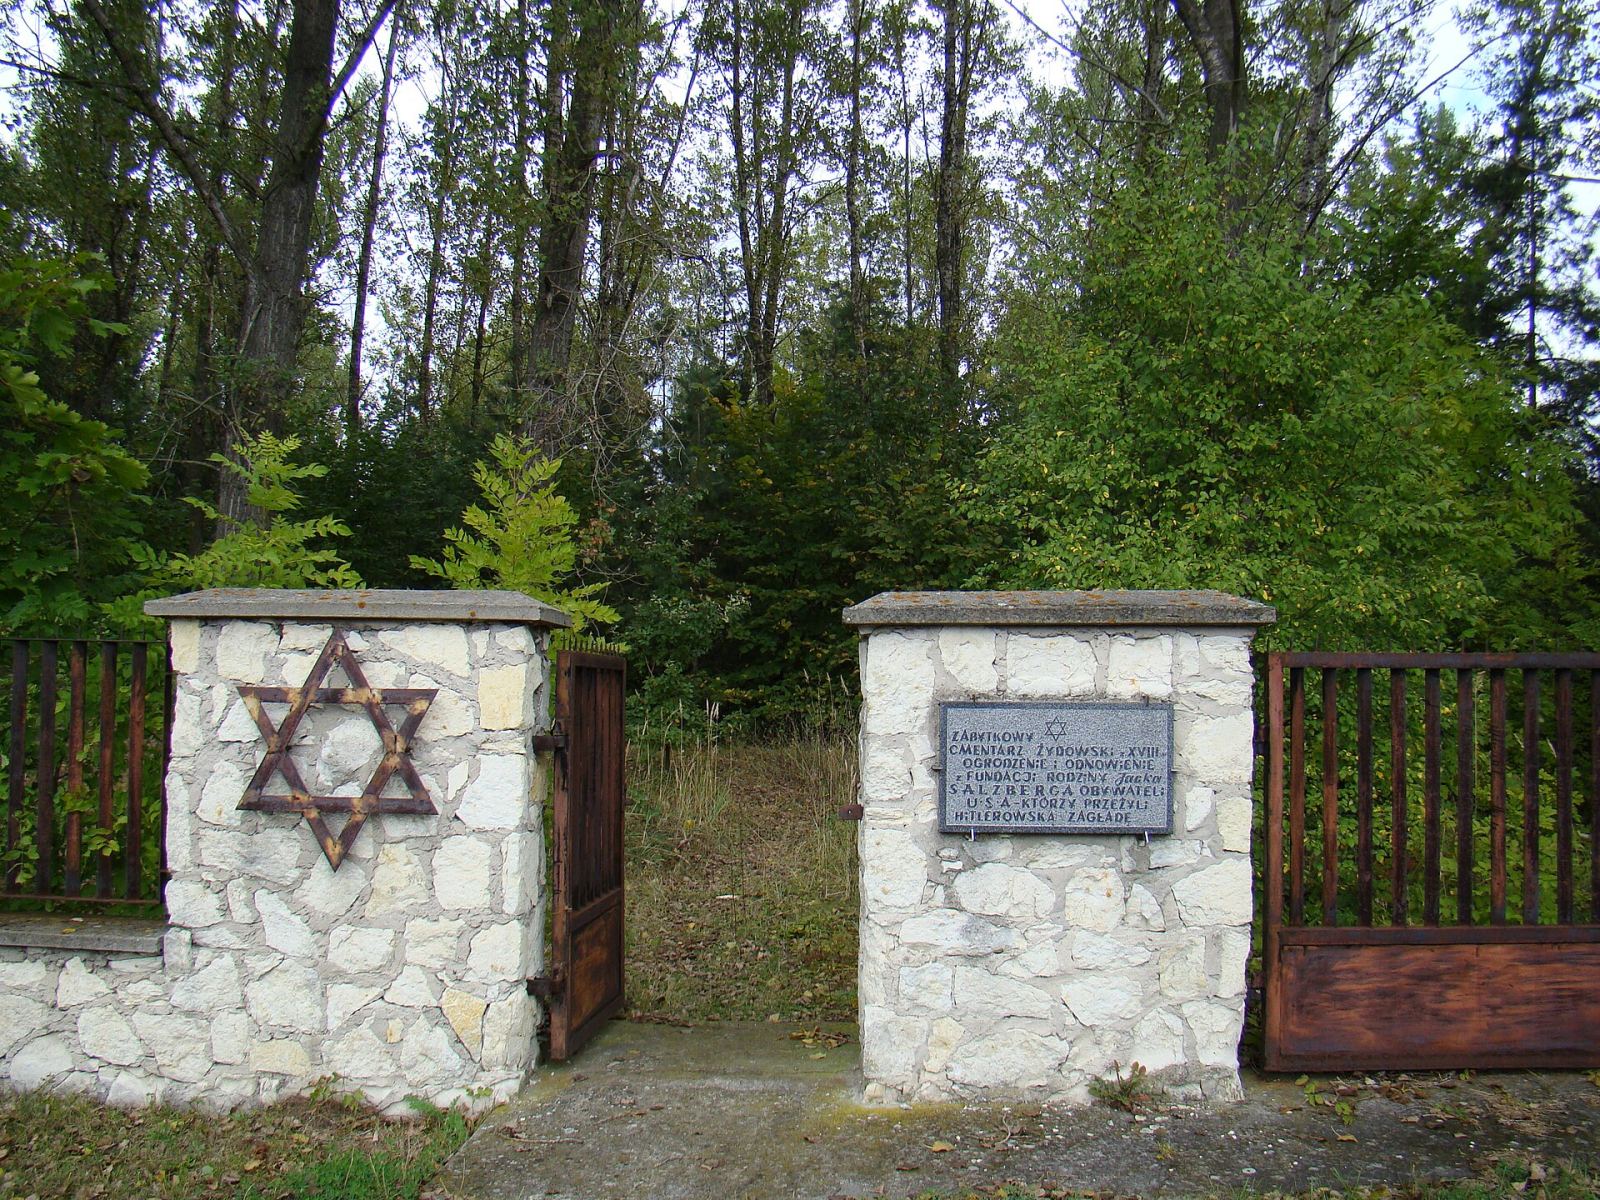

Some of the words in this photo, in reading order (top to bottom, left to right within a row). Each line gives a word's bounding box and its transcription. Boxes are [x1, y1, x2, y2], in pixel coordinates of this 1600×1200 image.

[951, 730, 1034, 742] ZABYTKOWY
[950, 744, 1024, 756] CMENTARZ
[1128, 749, 1159, 757] XVIII
[1114, 774, 1162, 786] Jacka
[948, 784, 1073, 797] SALZBERGA
